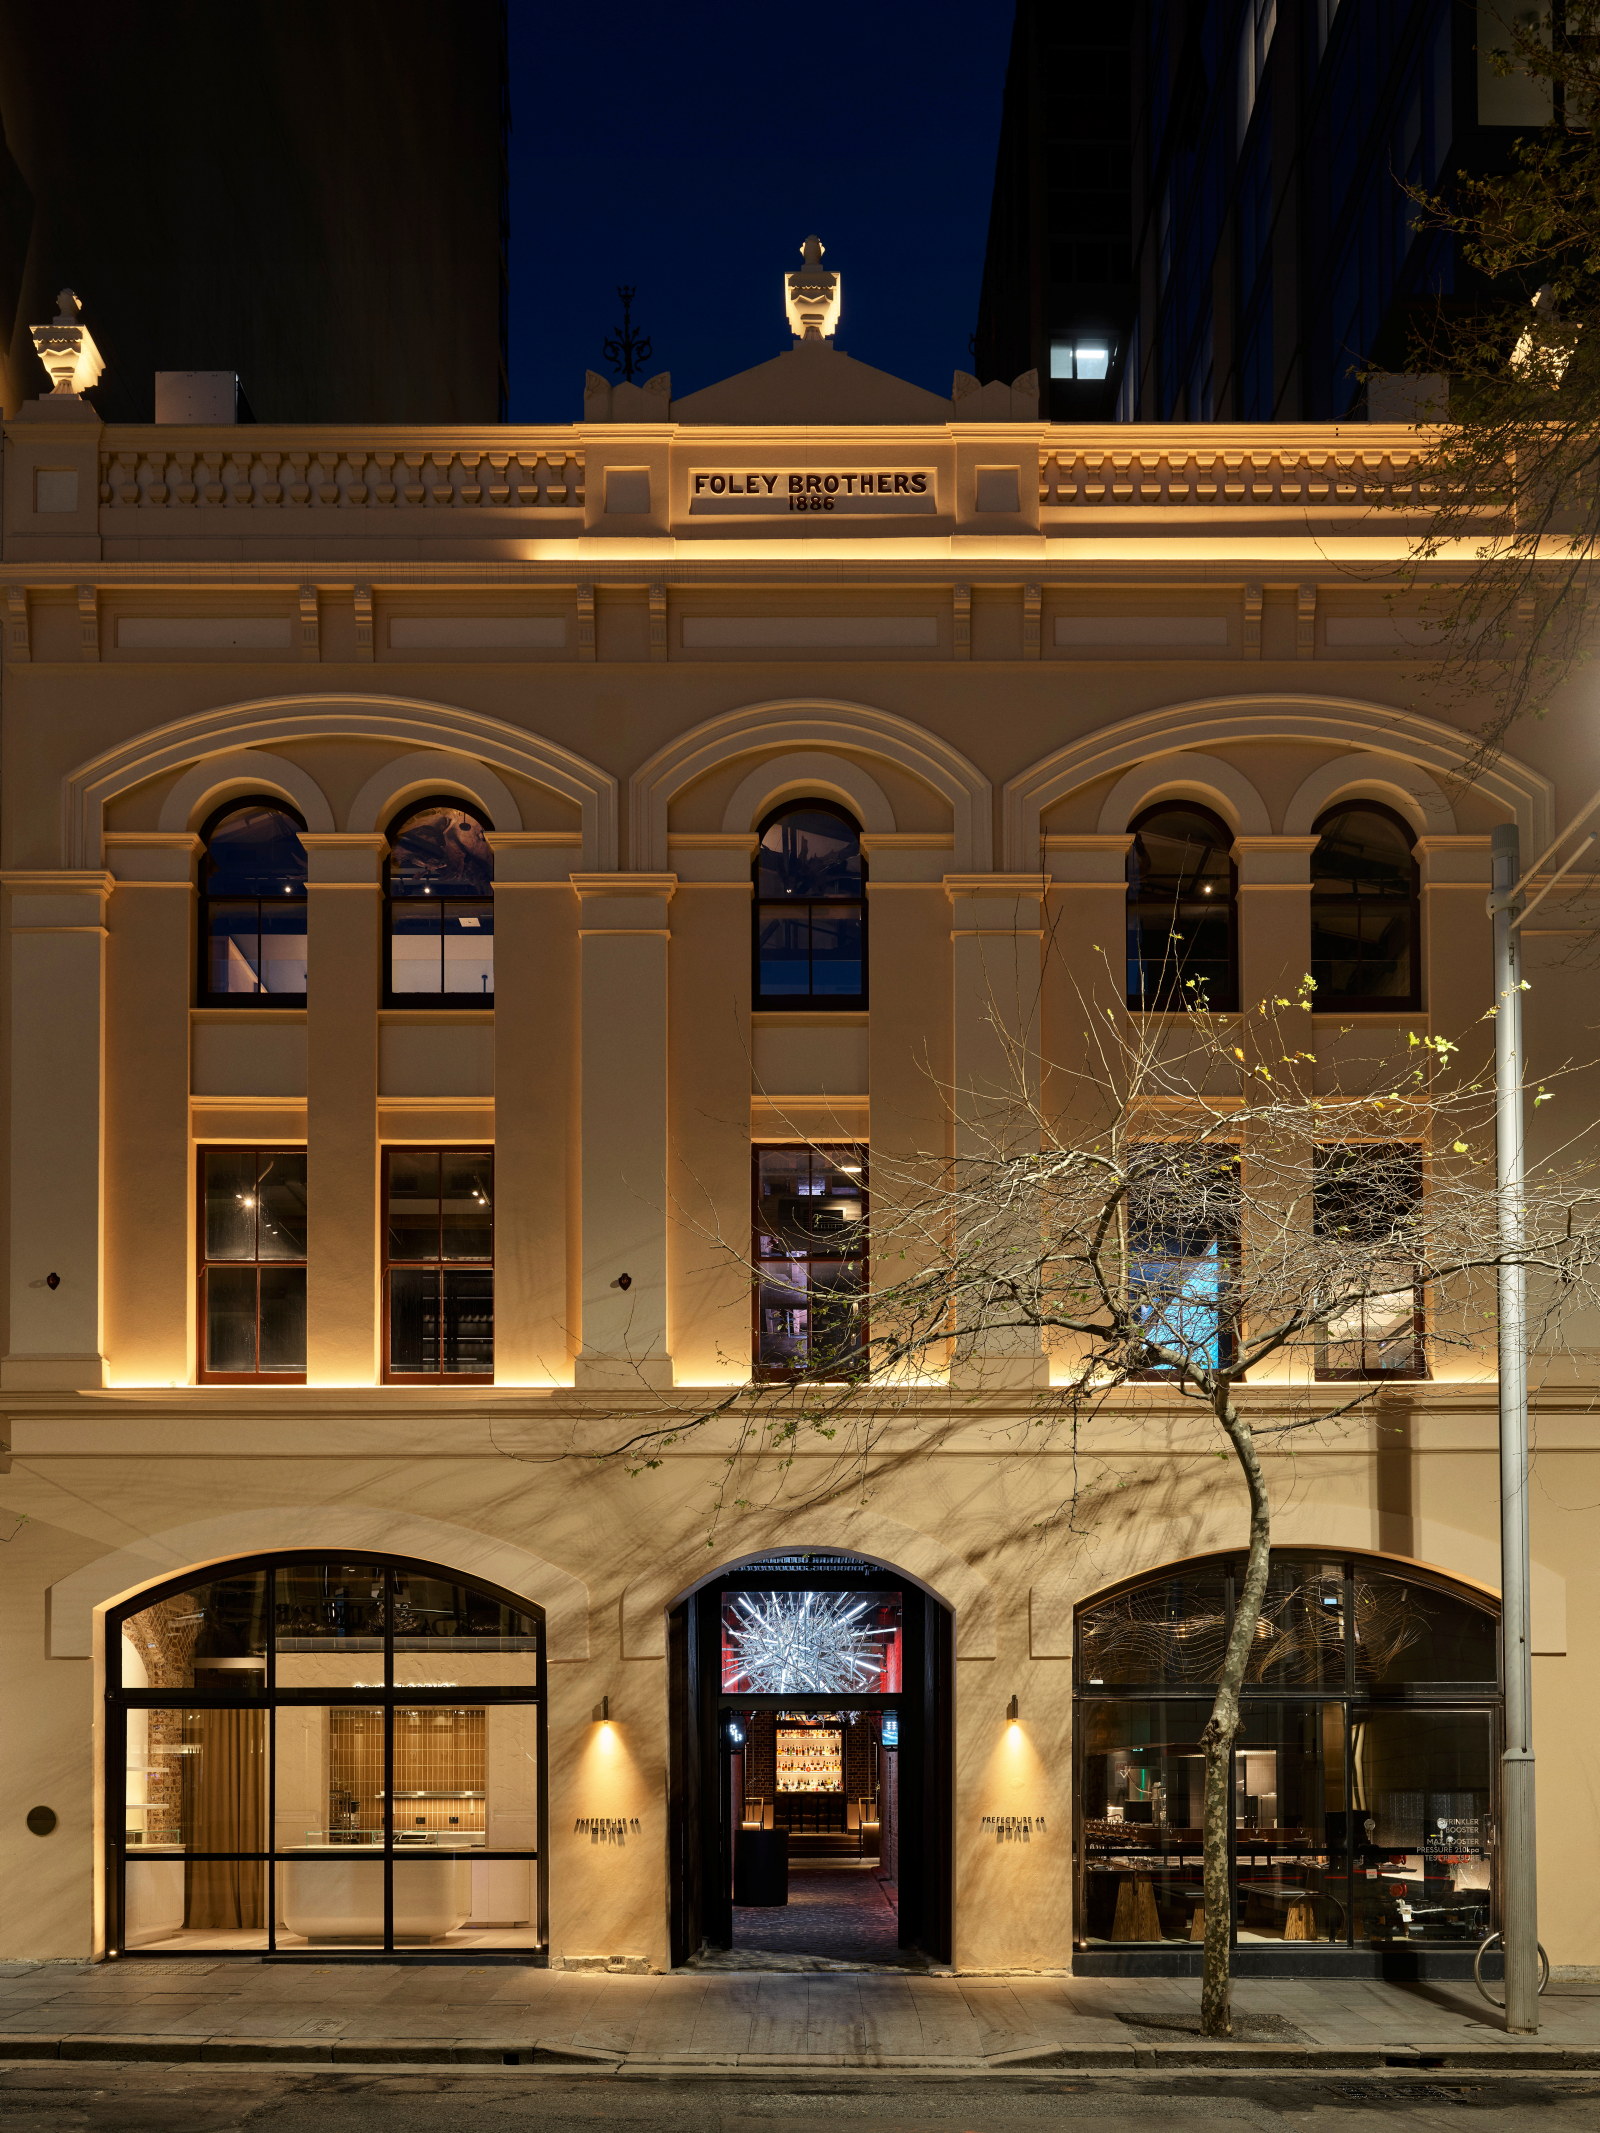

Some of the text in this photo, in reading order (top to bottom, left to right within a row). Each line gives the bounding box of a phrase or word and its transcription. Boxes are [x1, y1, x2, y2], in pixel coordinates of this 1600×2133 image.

[695, 474, 927, 494] FOLEY BROTHERS
[789, 495, 835, 511] 1886
